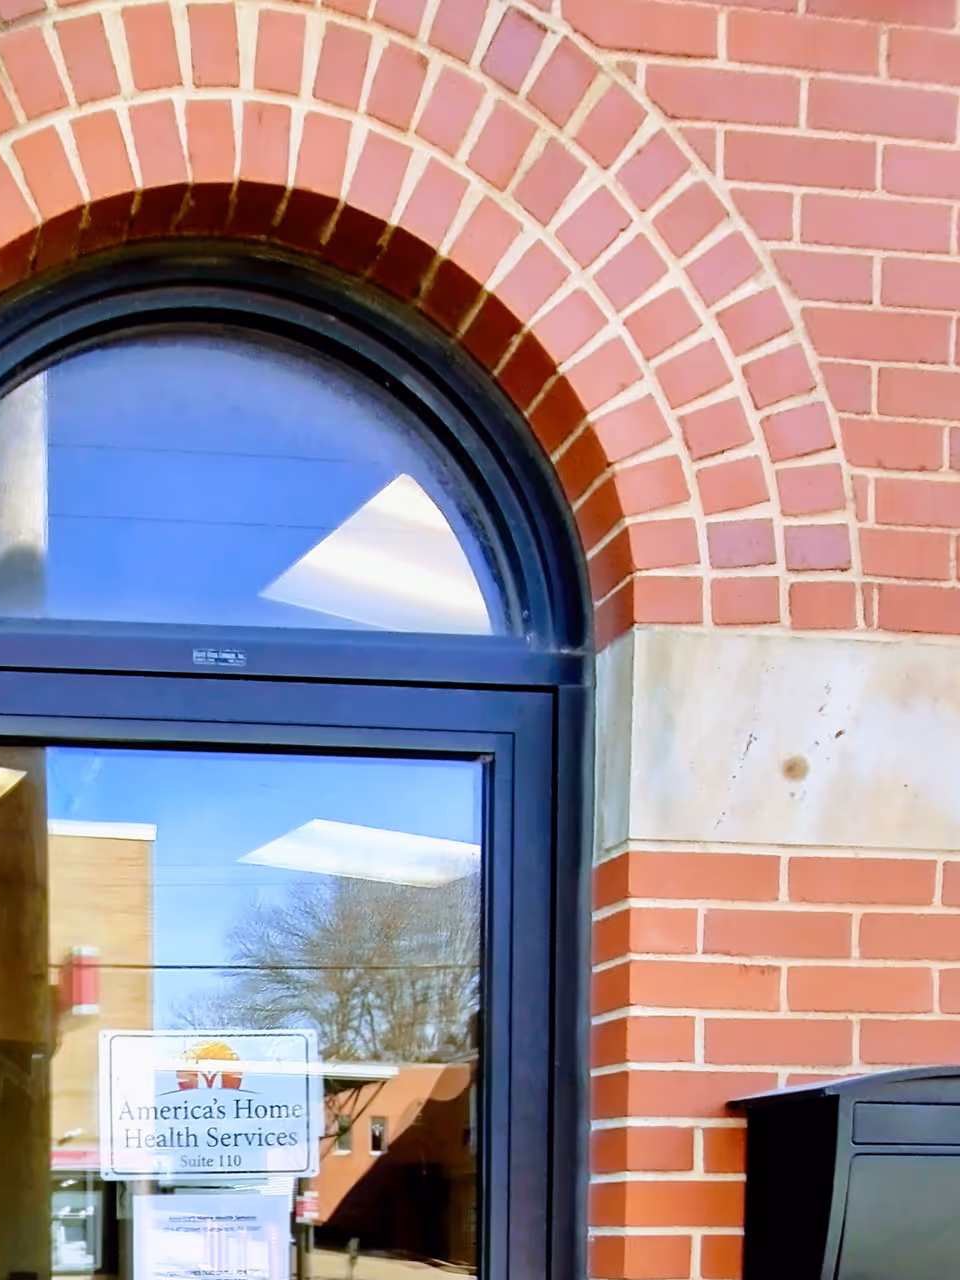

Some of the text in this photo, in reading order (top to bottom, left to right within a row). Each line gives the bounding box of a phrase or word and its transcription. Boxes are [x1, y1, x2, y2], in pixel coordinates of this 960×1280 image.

[118, 1098, 305, 1121] America's Home
[124, 1127, 298, 1148] Health Services
[180, 1154, 242, 1167] Suite 110
